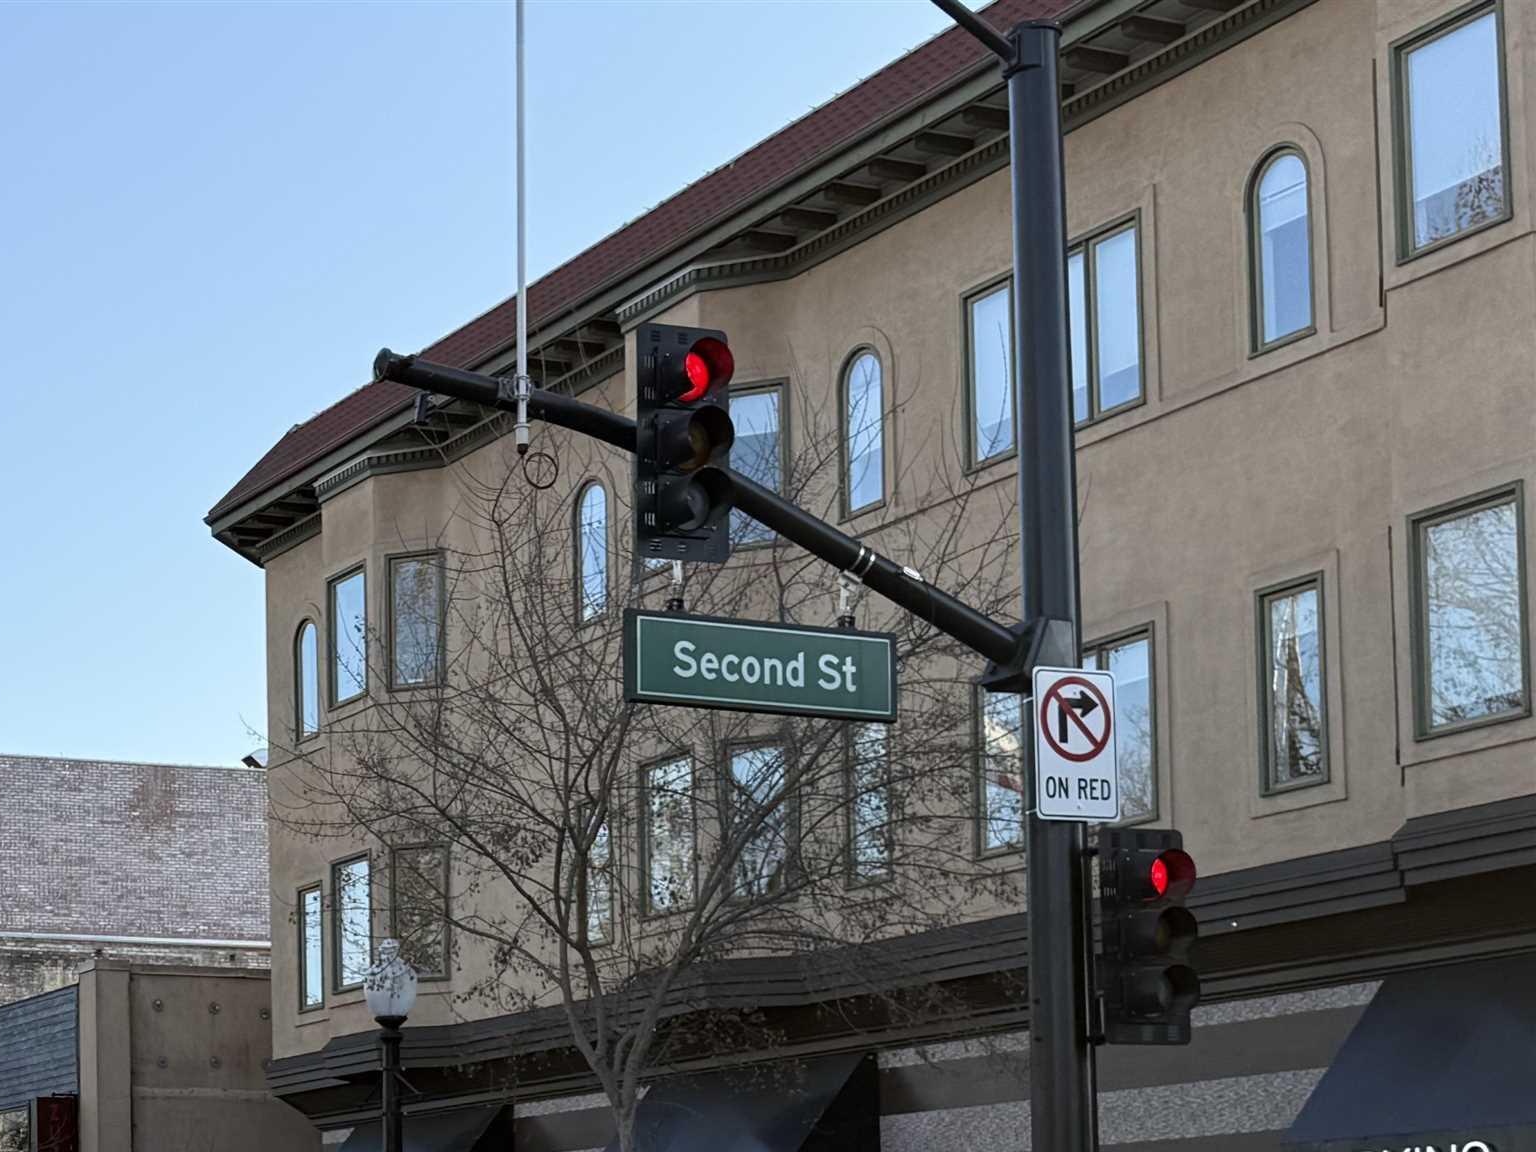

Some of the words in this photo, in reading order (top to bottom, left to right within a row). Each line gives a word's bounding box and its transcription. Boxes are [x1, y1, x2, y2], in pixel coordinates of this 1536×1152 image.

[673, 639, 805, 688] Second
[817, 653, 857, 693] St
[1045, 776, 1070, 800] ON
[1077, 777, 1112, 801] RED
